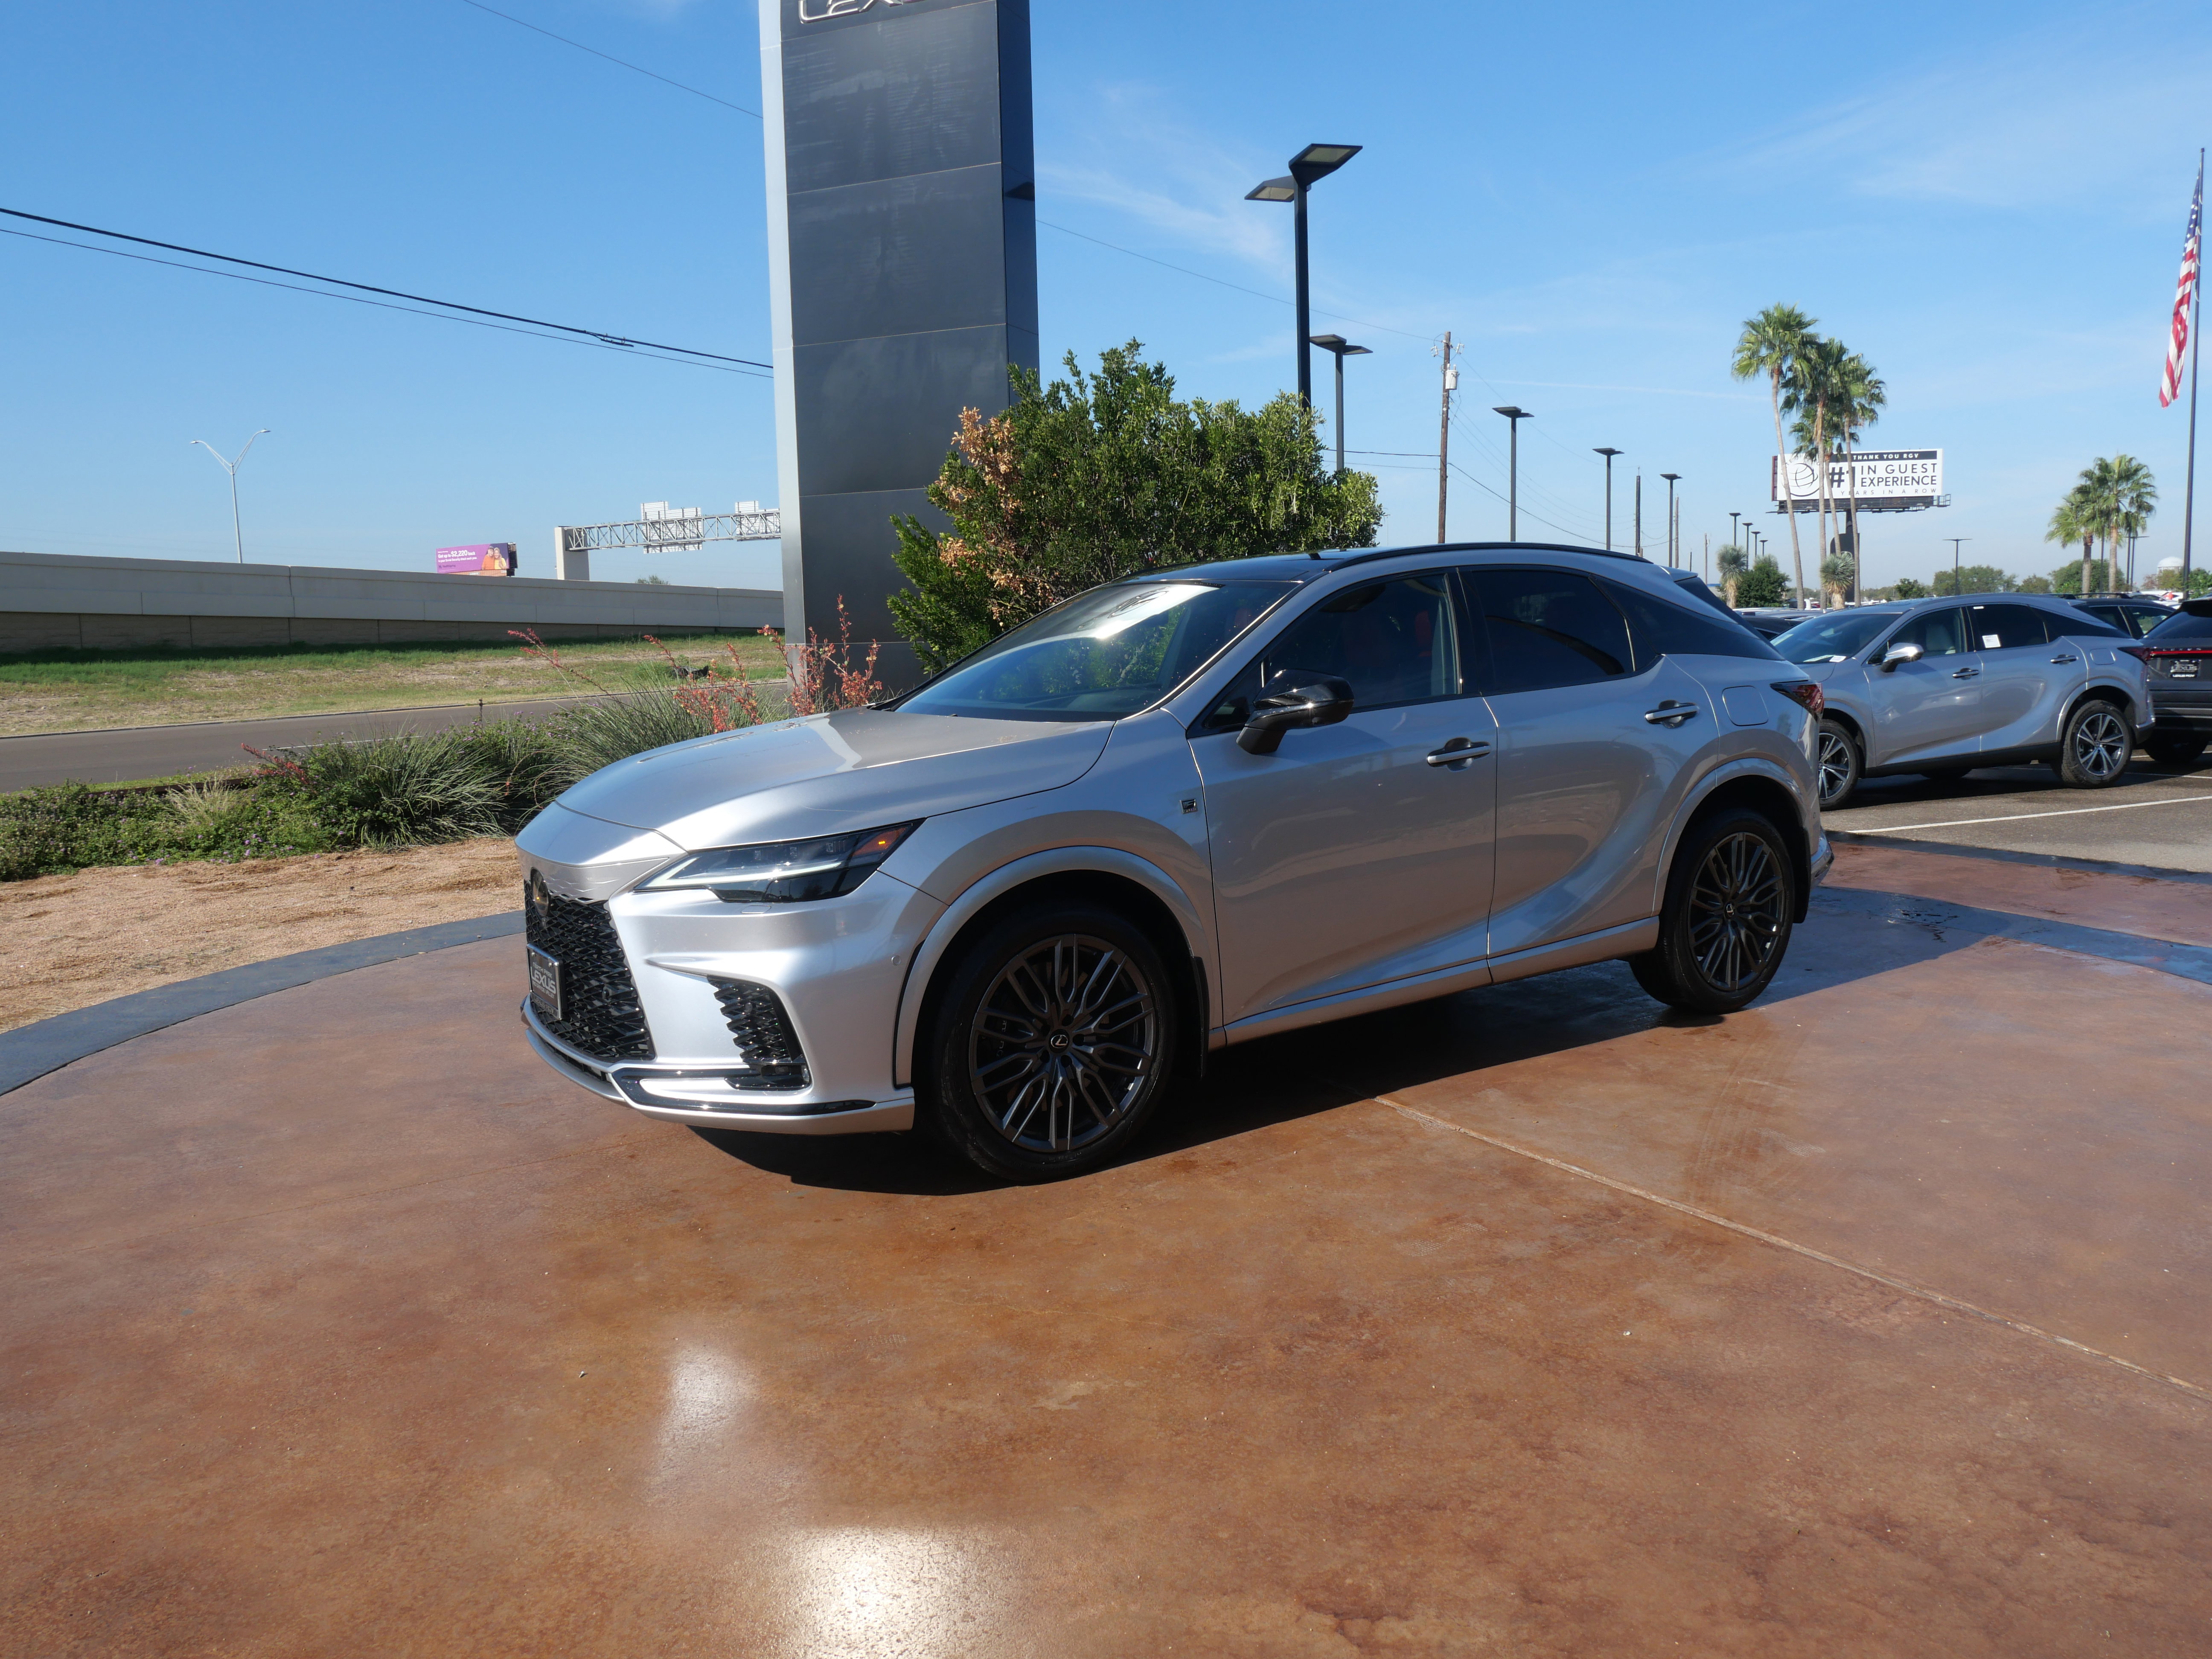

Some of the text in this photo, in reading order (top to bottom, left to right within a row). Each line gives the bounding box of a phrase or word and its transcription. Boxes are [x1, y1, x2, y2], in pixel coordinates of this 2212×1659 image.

[1861, 463, 1937, 475] IN GUEST
[1861, 475, 1937, 487] EXPERIENCE
[451, 550, 468, 558] $2,220
[530, 966, 556, 994] LEXUS
